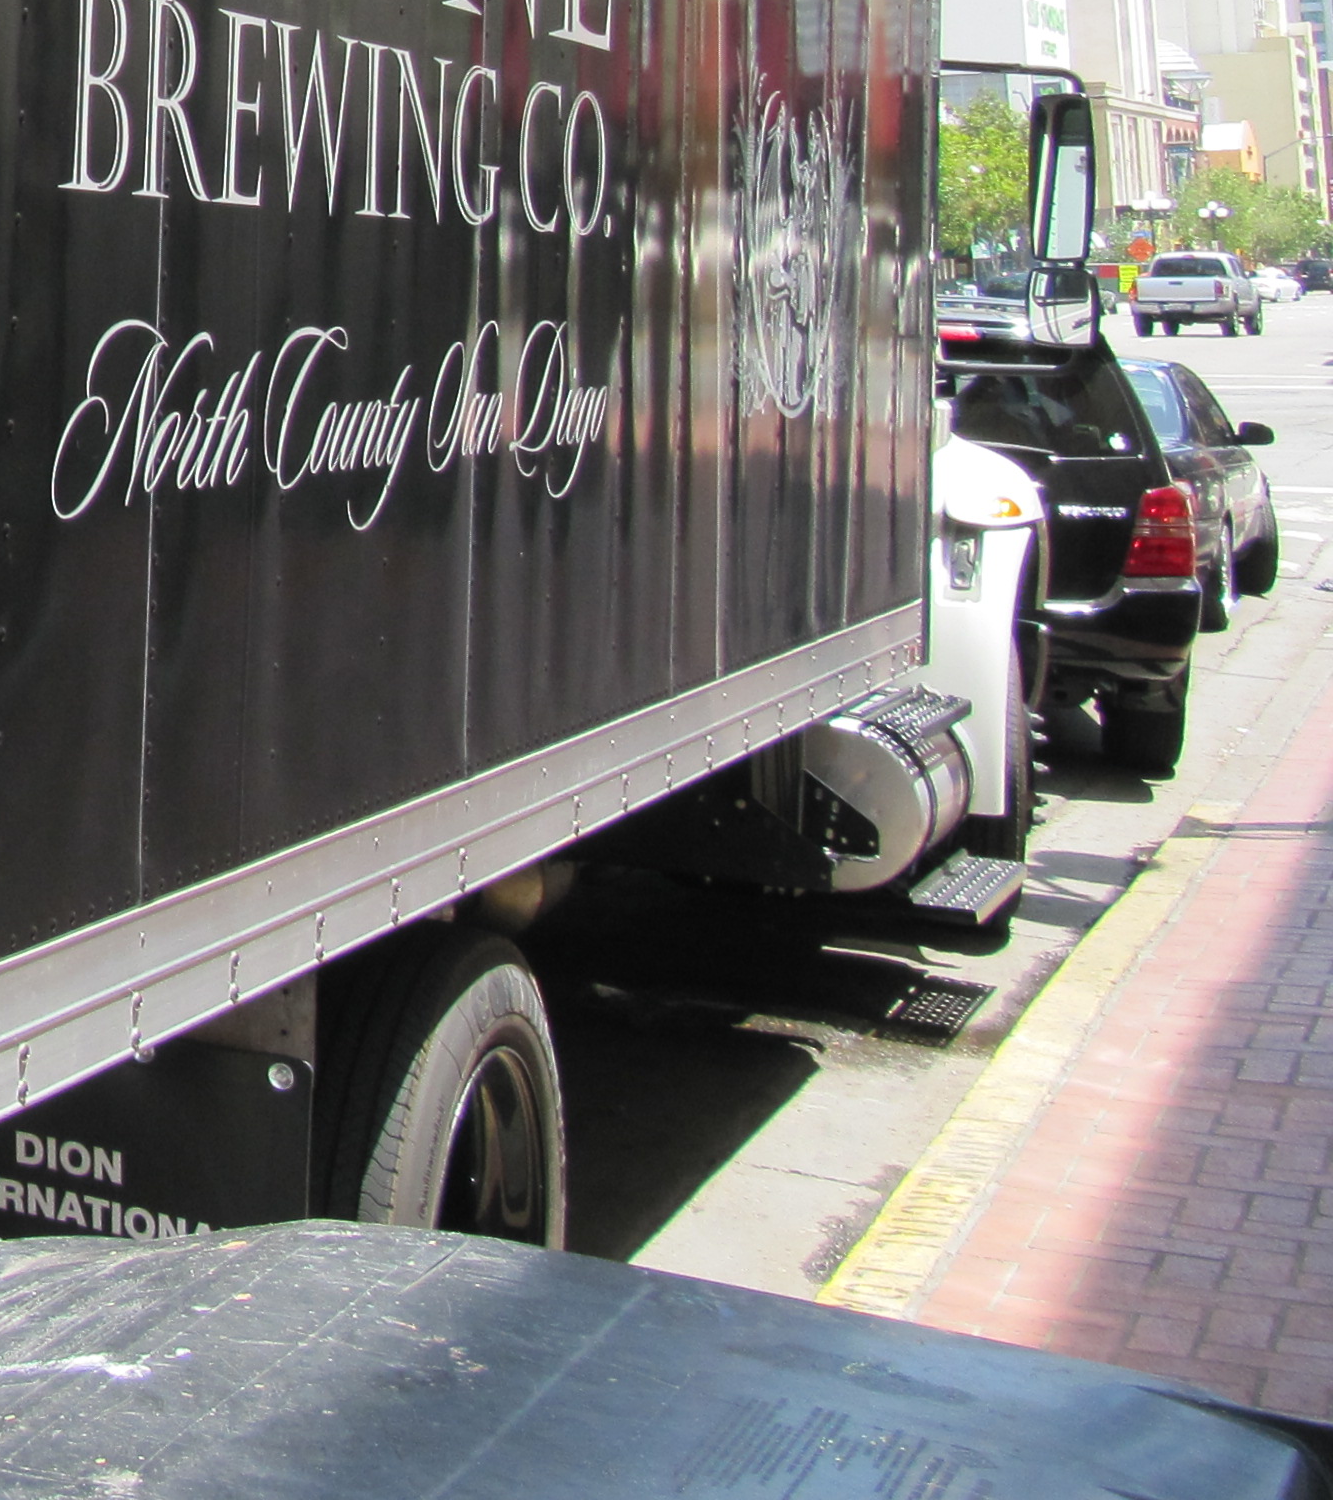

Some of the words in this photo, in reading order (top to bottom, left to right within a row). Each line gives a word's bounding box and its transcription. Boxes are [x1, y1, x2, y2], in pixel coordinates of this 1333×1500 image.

[520, 81, 612, 239] CO.
[52, 320, 261, 521] North
[264, 327, 420, 531] County
[428, 321, 504, 472] San
[511, 321, 608, 499] Diego
[16, 1130, 122, 1185] DION
